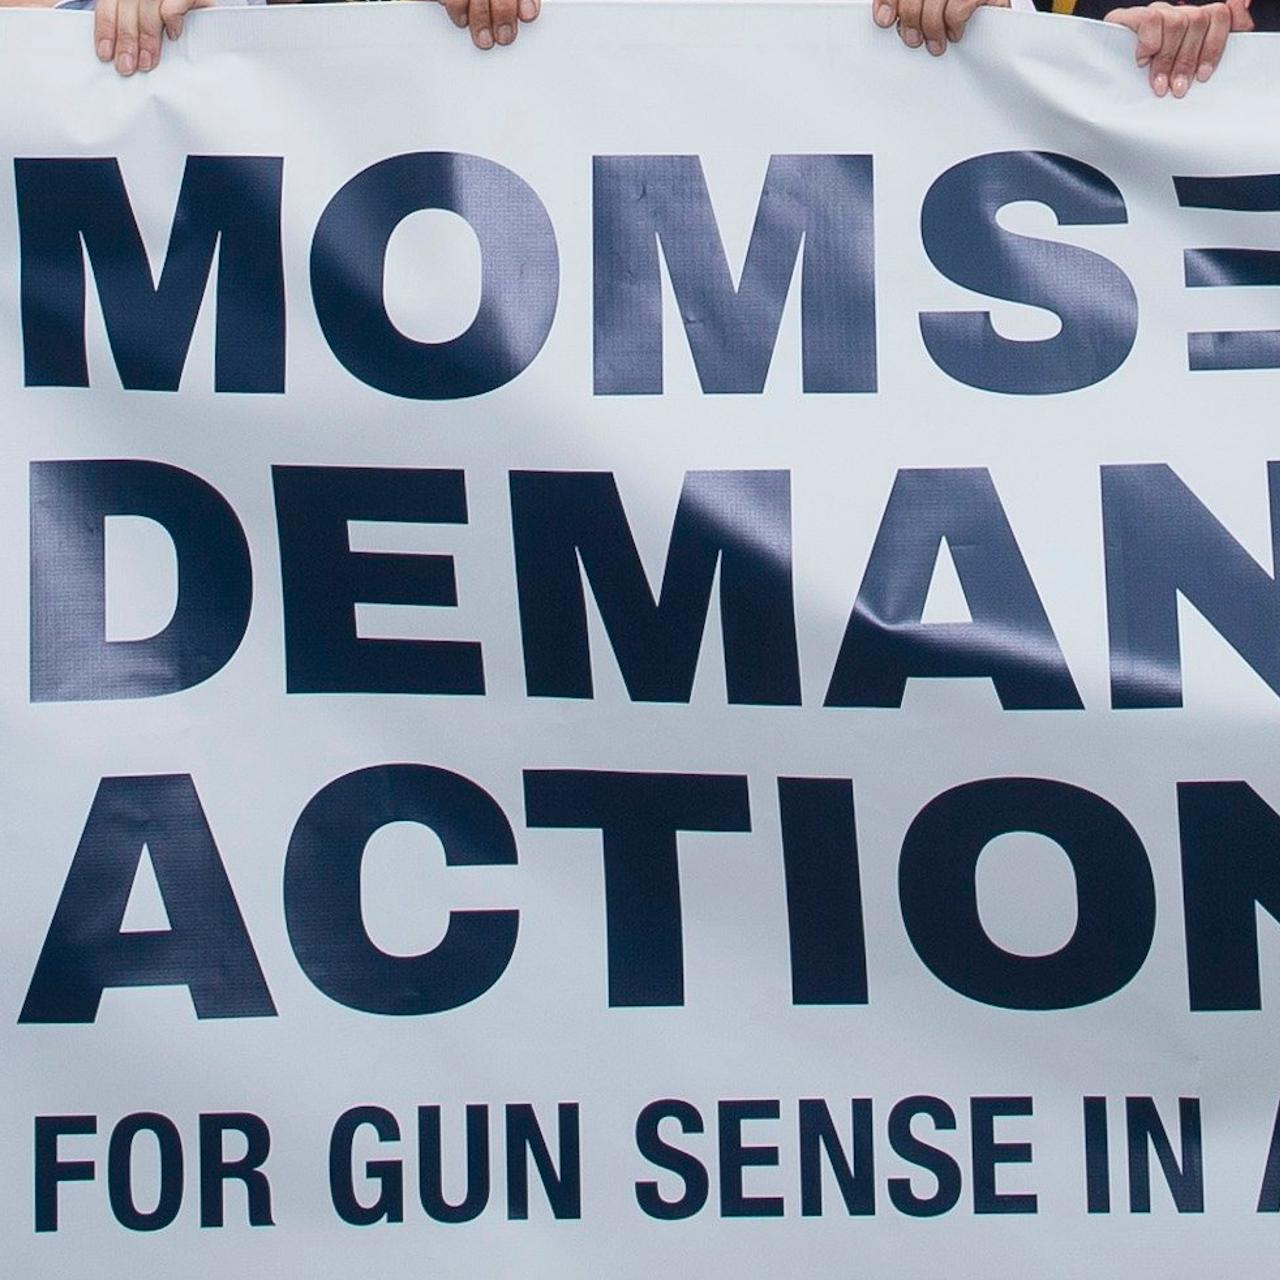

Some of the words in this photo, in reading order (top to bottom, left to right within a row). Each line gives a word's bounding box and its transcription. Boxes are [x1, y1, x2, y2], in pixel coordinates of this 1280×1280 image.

[12, 148, 1141, 400] MOMS
[31, 1111, 273, 1232] FOR
[328, 1101, 581, 1224] GUN
[634, 1095, 1035, 1219] SENSE
[1085, 1095, 1203, 1216] IN
